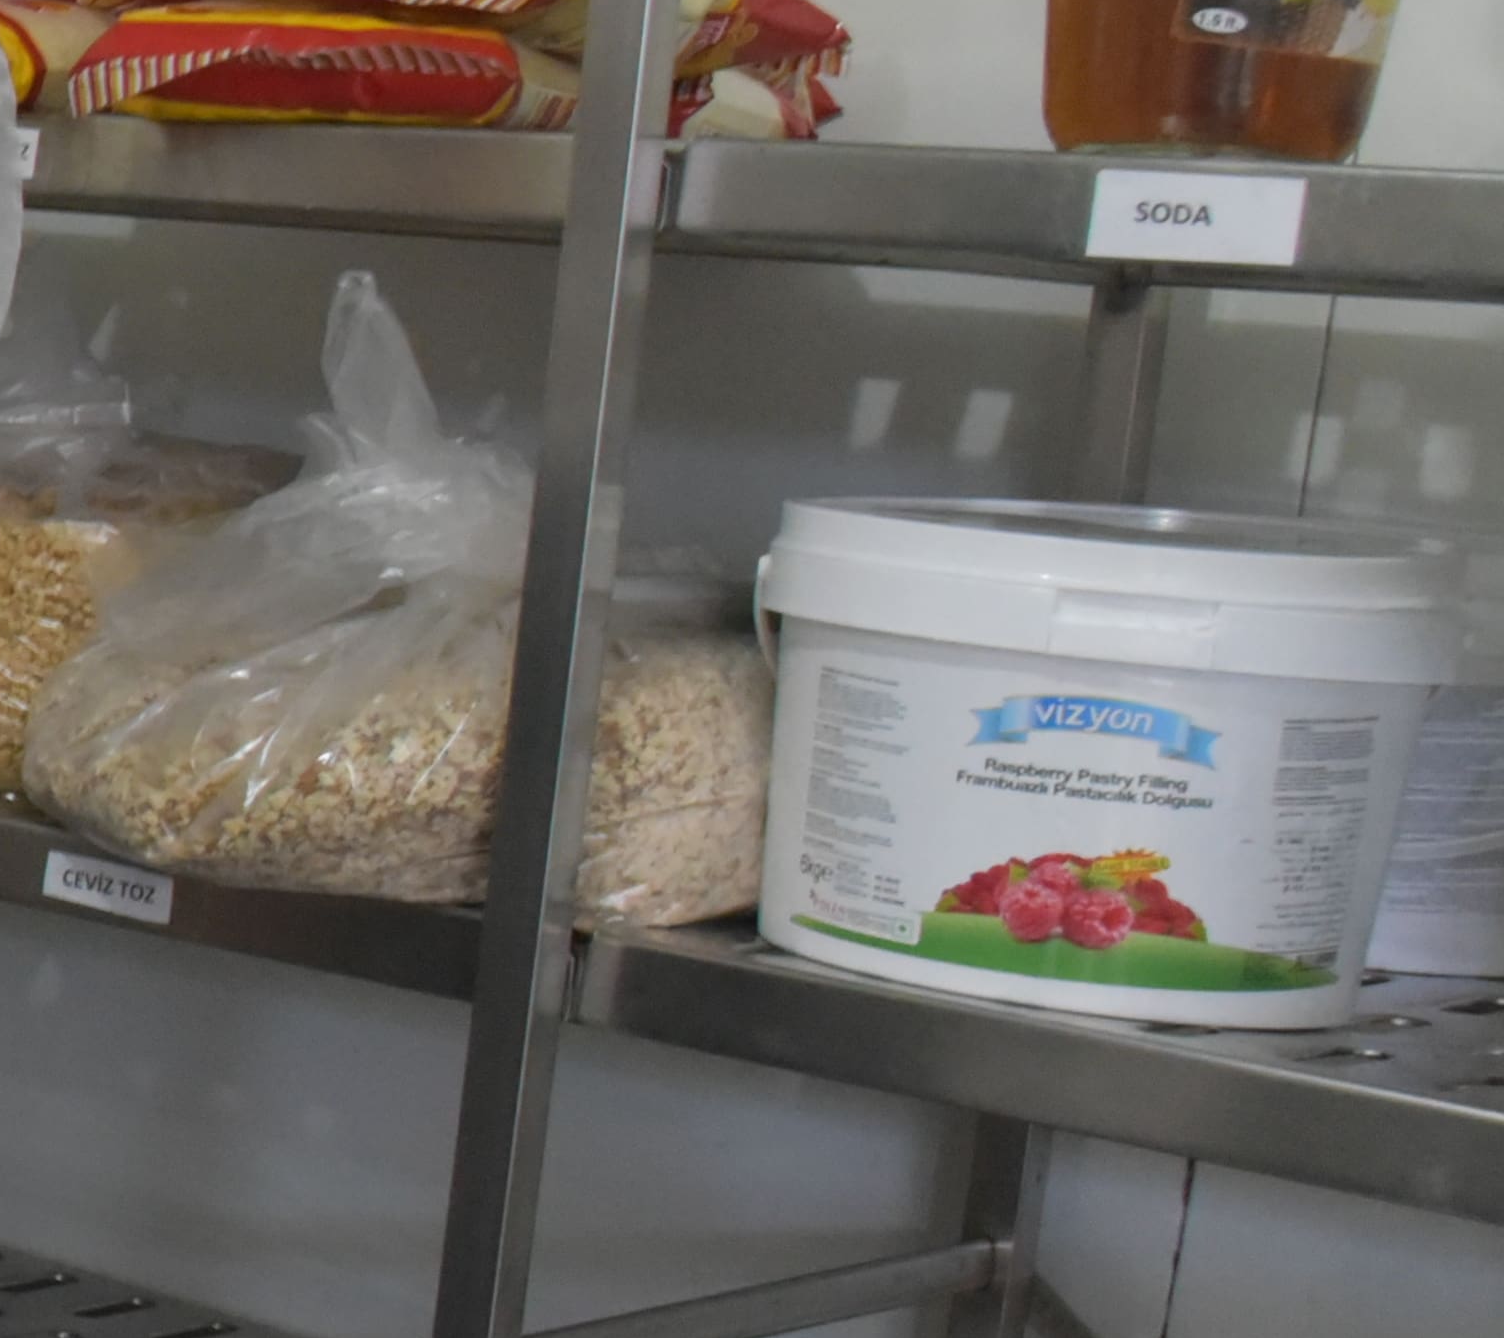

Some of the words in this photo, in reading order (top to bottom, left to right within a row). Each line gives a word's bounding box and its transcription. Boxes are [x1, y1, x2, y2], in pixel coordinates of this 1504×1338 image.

[1134, 201, 1212, 227] SODA
[1035, 697, 1153, 734] vizyon
[984, 758, 1074, 783] Raspberry
[1078, 768, 1133, 789] Pastry
[1139, 773, 1189, 793] Filling
[1142, 791, 1214, 810] Dolgusu
[62, 868, 114, 897] CEVİZ
[119, 881, 156, 905] TOZ
